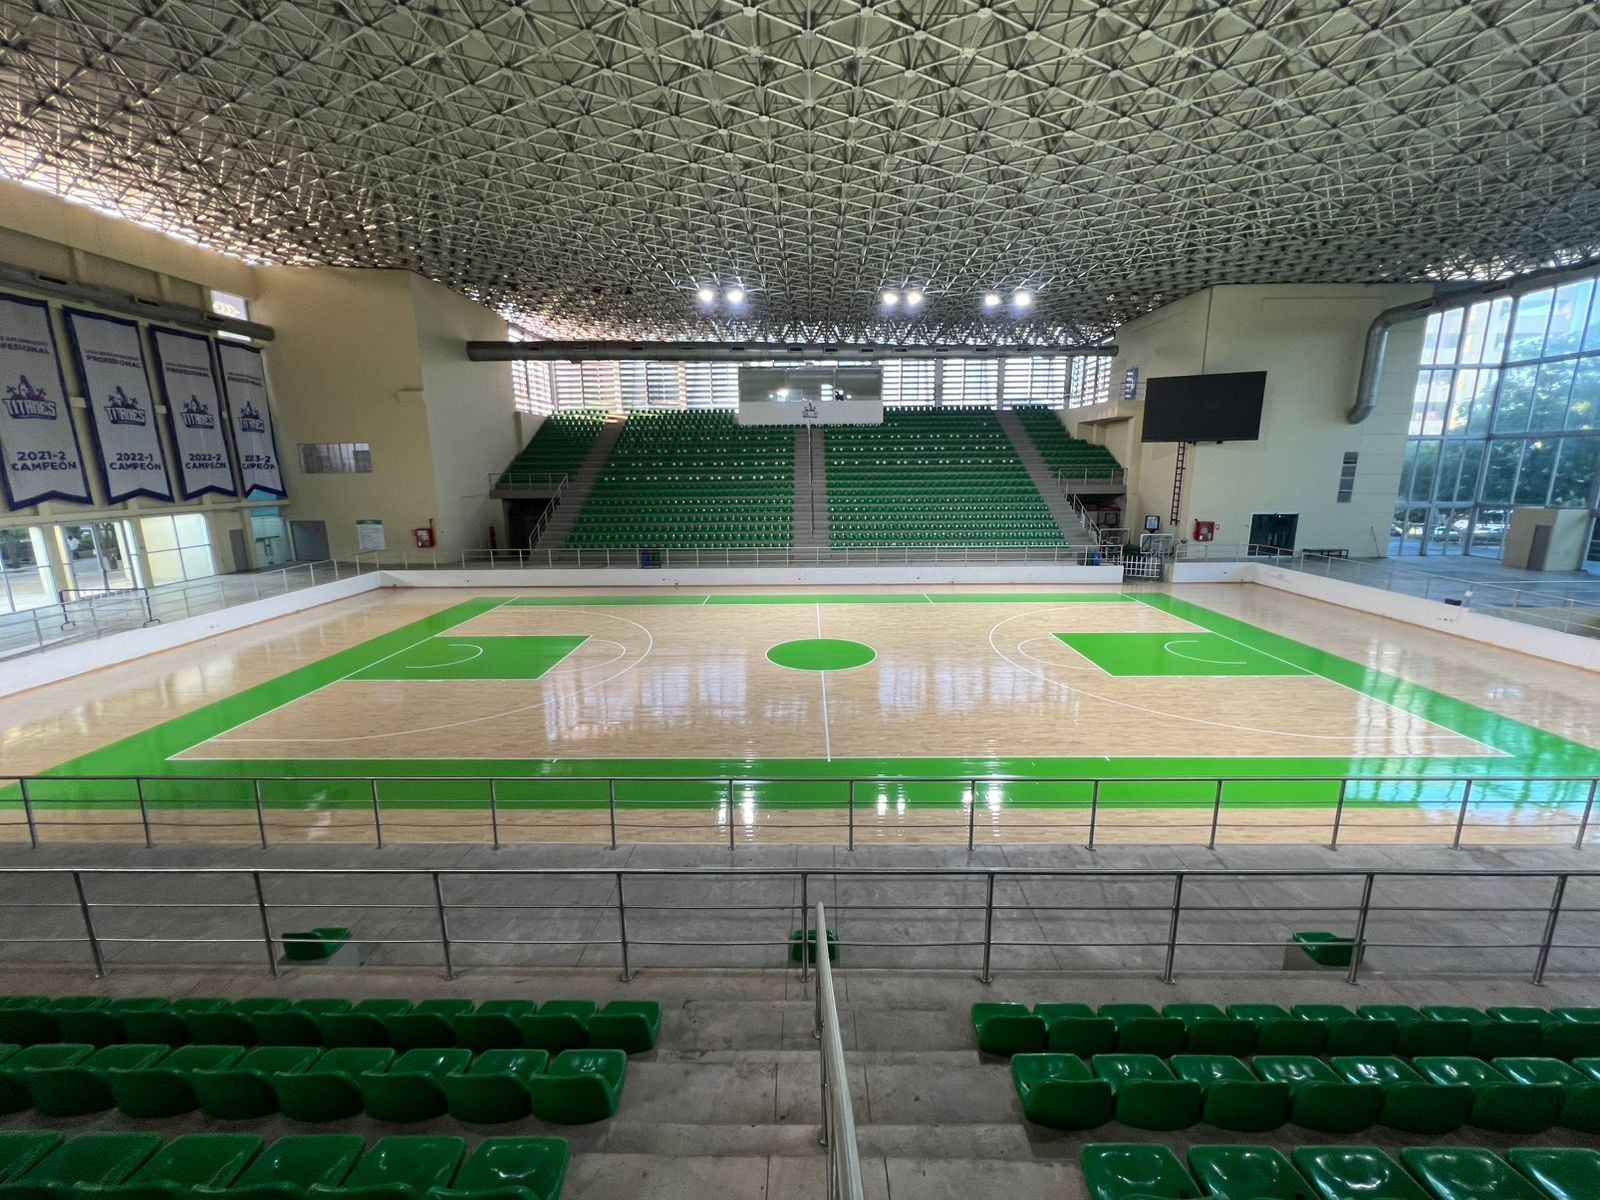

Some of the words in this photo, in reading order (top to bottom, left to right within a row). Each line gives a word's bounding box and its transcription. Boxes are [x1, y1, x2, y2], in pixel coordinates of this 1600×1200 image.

[17, 451, 67, 461] 2021-2
[116, 452, 153, 462] 2022-1
[188, 453, 222, 461] 2022-2
[244, 455, 271, 463] 23-2
